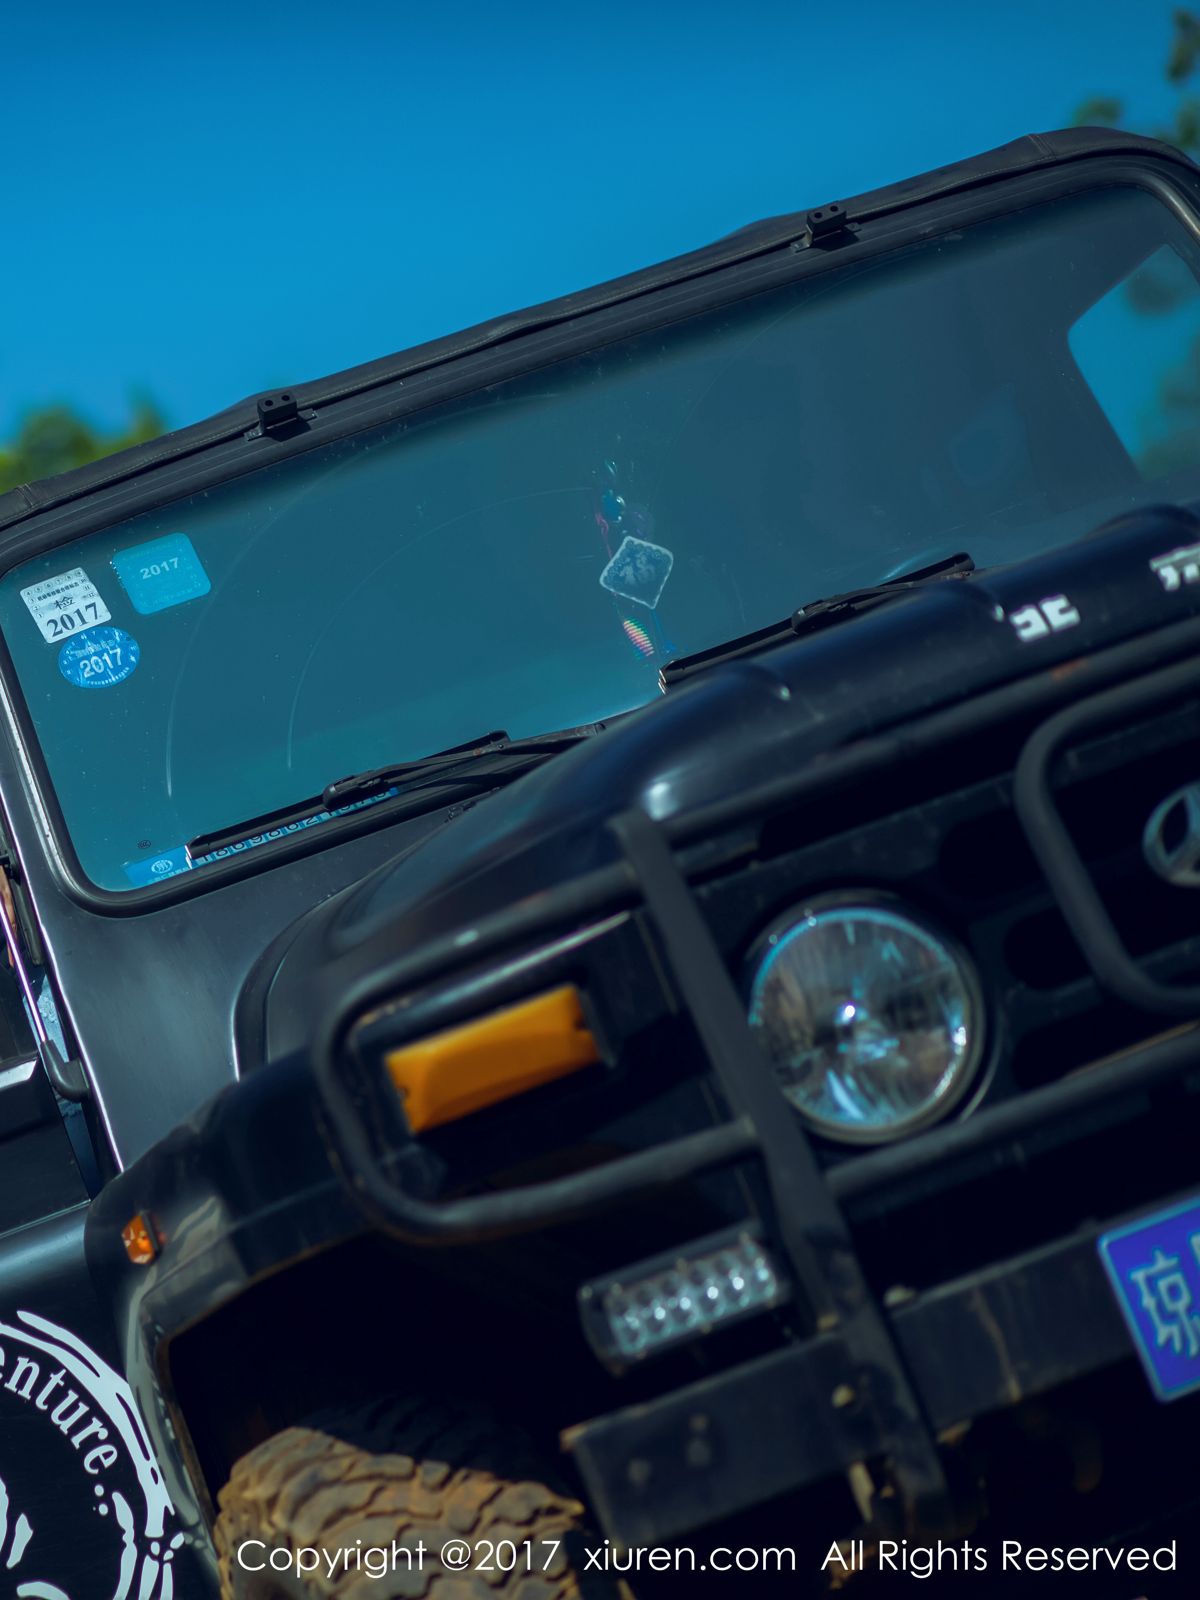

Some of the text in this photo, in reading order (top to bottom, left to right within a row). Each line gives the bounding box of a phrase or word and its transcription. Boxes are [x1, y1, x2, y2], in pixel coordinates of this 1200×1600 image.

[140, 557, 179, 580] 2017
[46, 602, 99, 638] 2017
[79, 647, 122, 679] 2017
[1128, 1229, 1200, 1360] 琼
